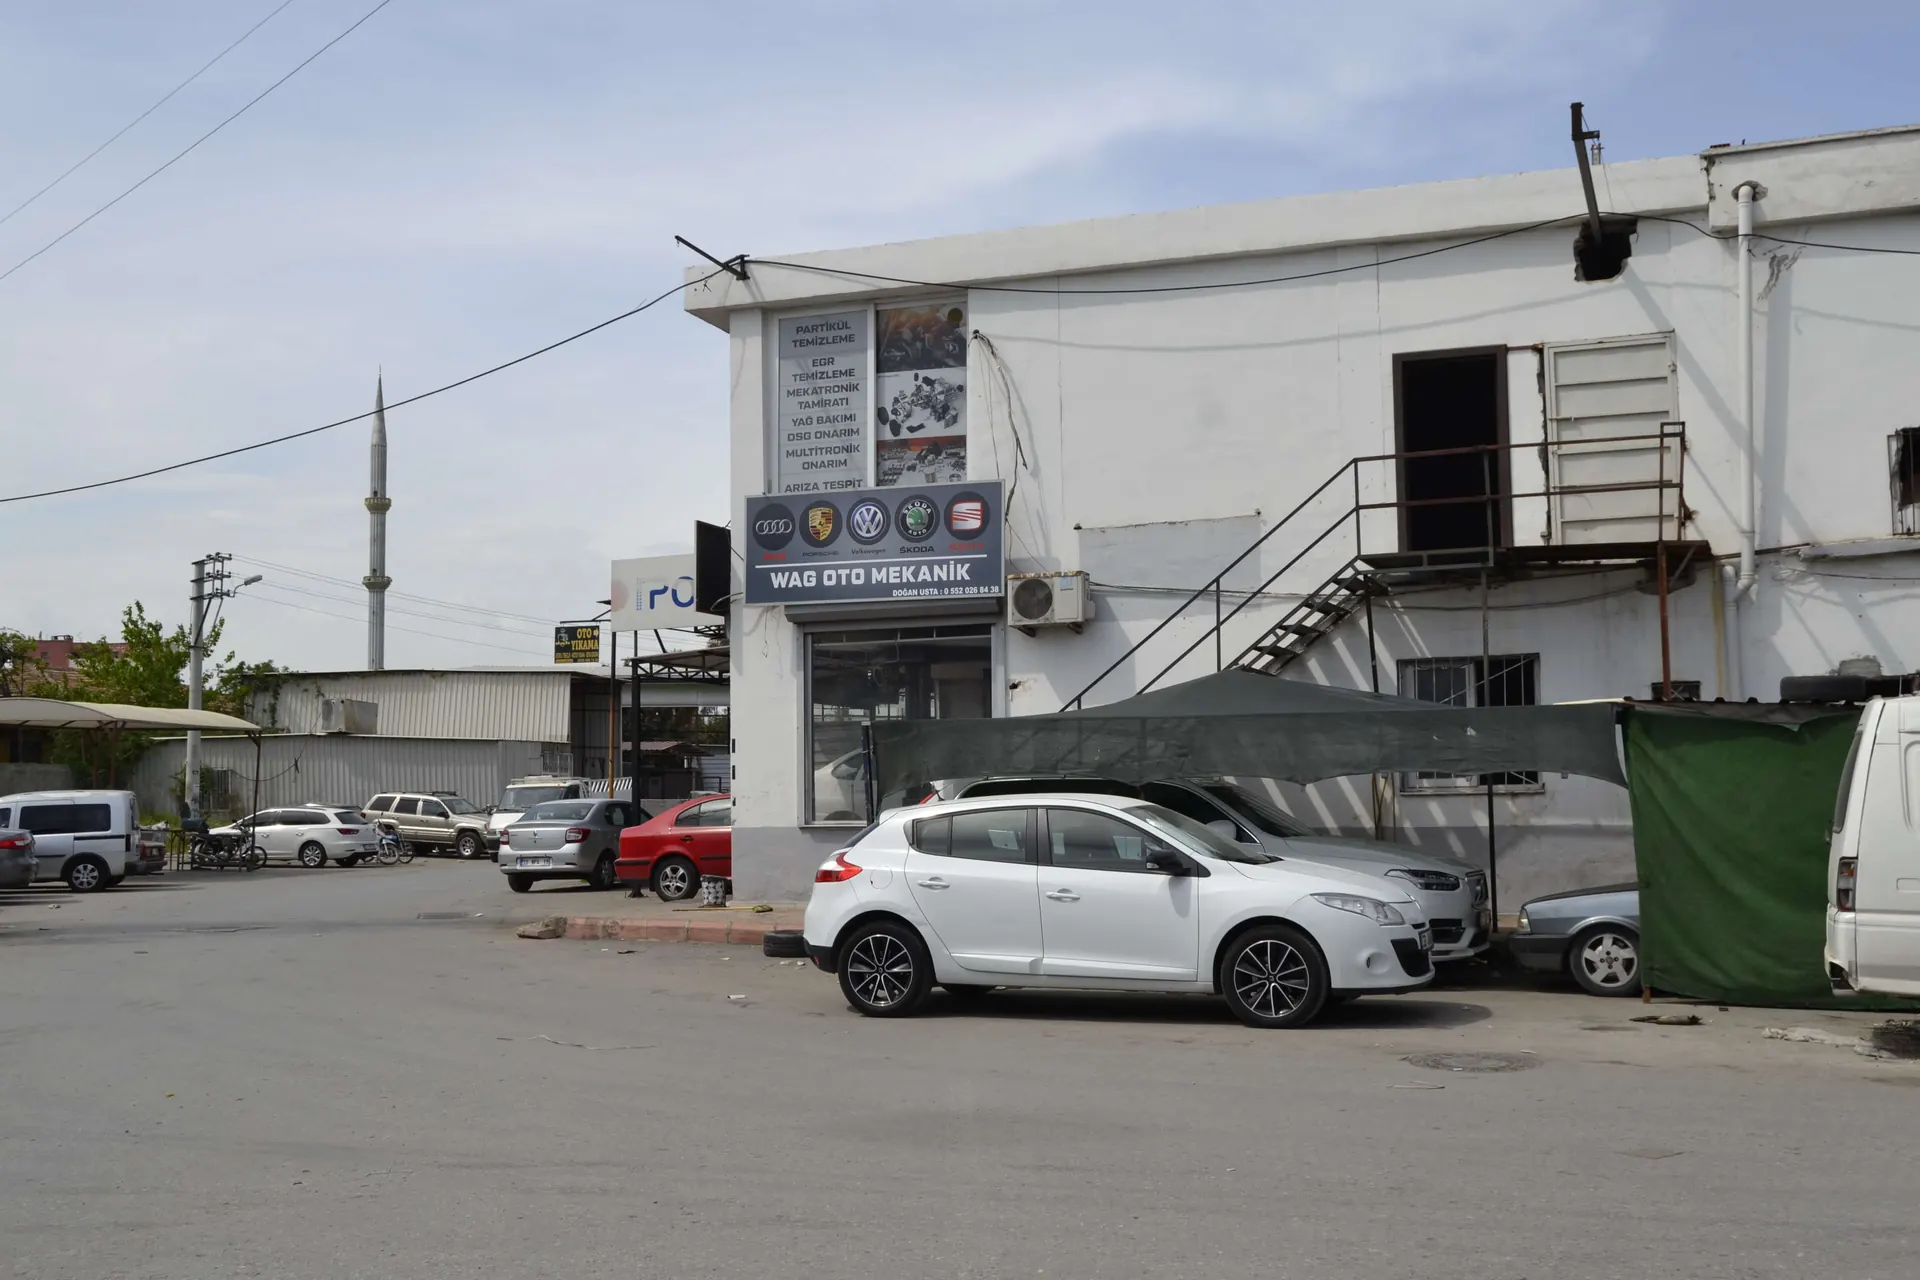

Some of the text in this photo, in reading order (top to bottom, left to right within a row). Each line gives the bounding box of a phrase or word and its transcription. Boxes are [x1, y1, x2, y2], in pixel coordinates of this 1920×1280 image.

[796, 320, 851, 335] PARTİKÜL
[792, 334, 855, 348] TEMİZLEME
[812, 357, 835, 367] EGR
[792, 368, 855, 382] TEMİZLEME
[786, 381, 860, 398] MEKATRONİK
[798, 397, 849, 410] TAMİRATI
[792, 413, 856, 426] YAĞ BAKIMI
[787, 428, 860, 442] DSG ONARIM
[786, 443, 860, 458] MULTİTRONİK
[802, 459, 848, 470] ONARIM
[784, 478, 863, 493] ARIZA TESPİT
[770, 560, 971, 588] WAG OTO MEKANİK
[892, 587, 918, 597] DOĞAN
[919, 588, 939, 596] USTA
[950, 587, 963, 595] 552
[965, 586, 978, 594] 026
[979, 586, 989, 594] 84
[990, 585, 999, 593] 38
[576, 628, 592, 639] OTO
[571, 639, 599, 650] YIKAMA
